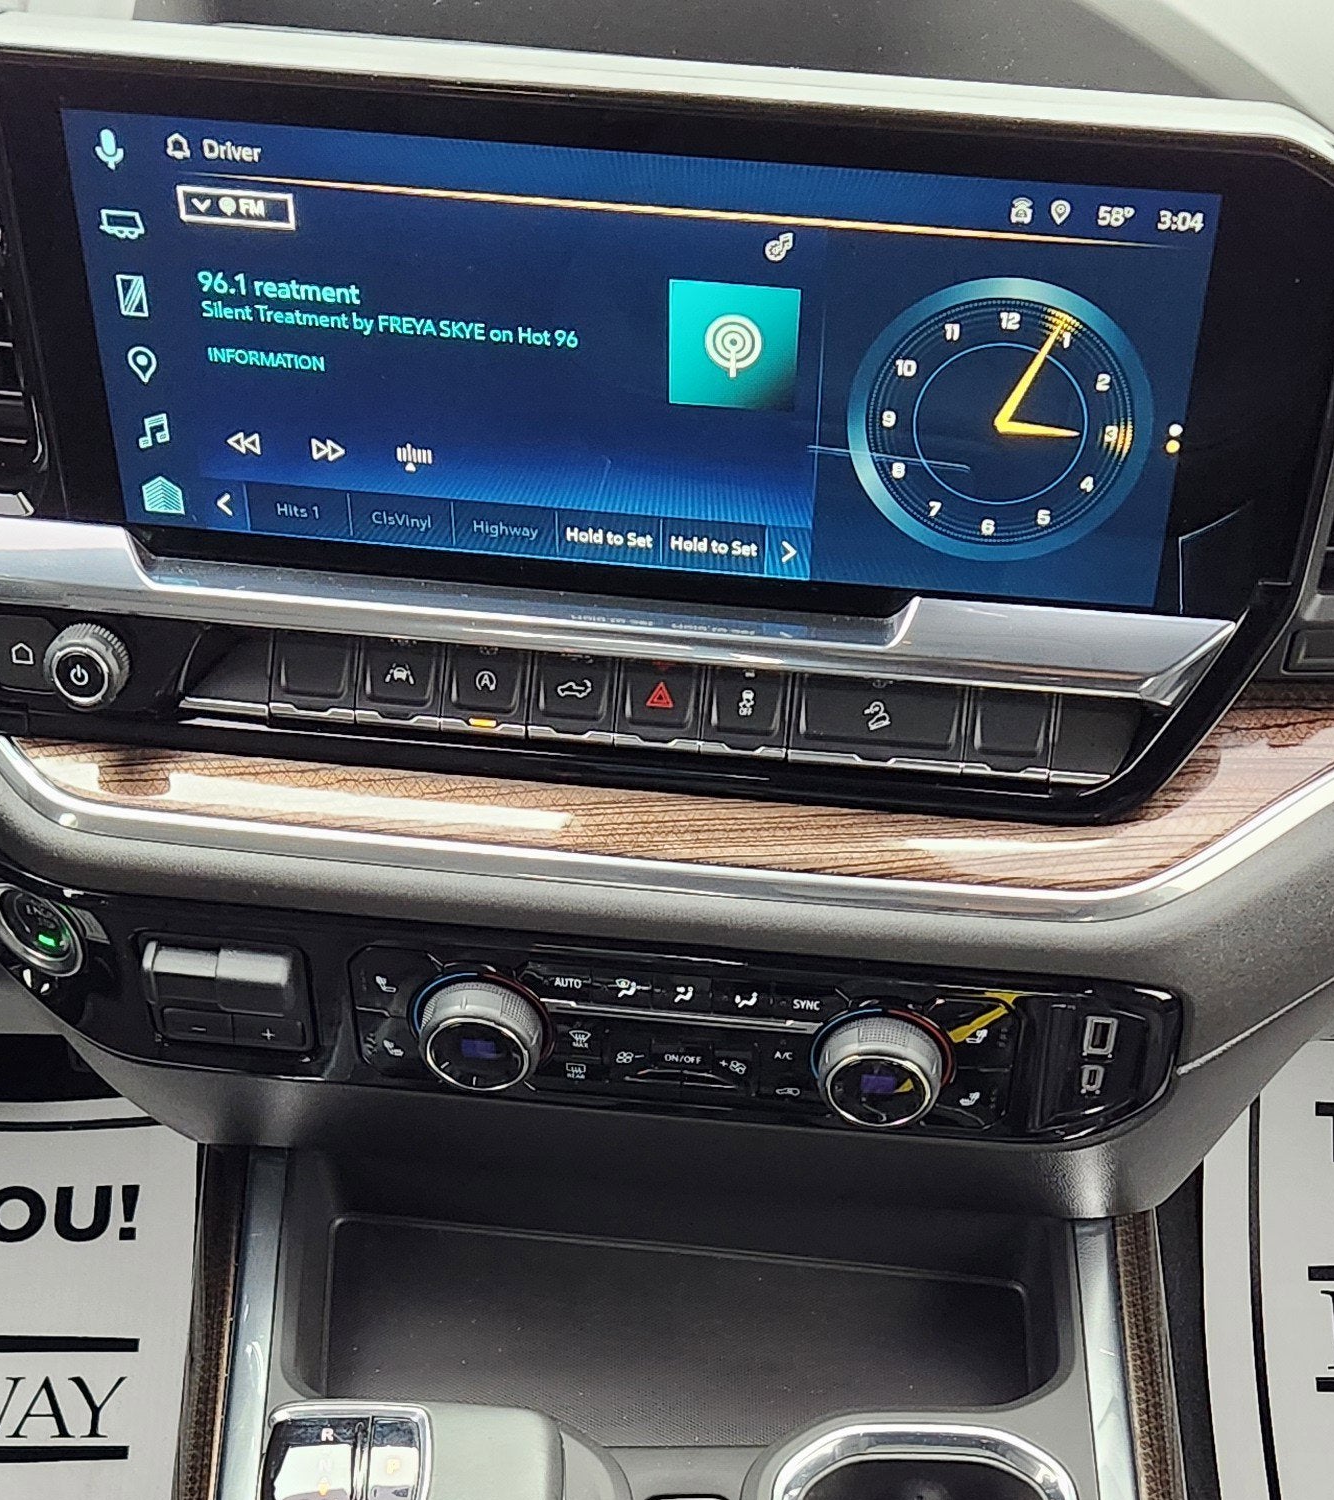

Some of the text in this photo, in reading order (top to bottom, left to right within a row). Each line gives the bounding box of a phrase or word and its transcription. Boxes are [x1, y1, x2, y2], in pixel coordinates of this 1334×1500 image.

[202, 139, 262, 162] Driver
[238, 198, 265, 217] FM
[1157, 210, 1205, 233] 3:04
[197, 270, 360, 305] 96.1 reatment
[201, 300, 579, 349] Silent Treatment by FREYA SKYE on Hot 96
[999, 311, 1021, 330] 12
[944, 323, 961, 341] 11
[1061, 332, 1072, 349] 1
[207, 346, 326, 372] INFORMATION
[895, 359, 917, 377] 10
[1095, 373, 1111, 391] 2
[881, 409, 897, 428] 9
[1104, 424, 1119, 443] 3
[890, 462, 906, 479] 8
[1079, 475, 1095, 493] 4
[277, 502, 320, 519] Hits 1
[928, 500, 943, 518] 7
[1036, 508, 1051, 526] 5
[371, 511, 432, 530] ClsVinyl
[980, 518, 995, 535] 6
[472, 519, 539, 541] Highway
[566, 527, 653, 548] Hold to Set
[670, 535, 758, 557] Hold to Set
[554, 977, 582, 989] AUTO
[793, 998, 820, 1011] SYNC
[664, 1053, 703, 1065] ON/OFF
[774, 1051, 793, 1061] A/C
[320, 1428, 335, 1442] R
